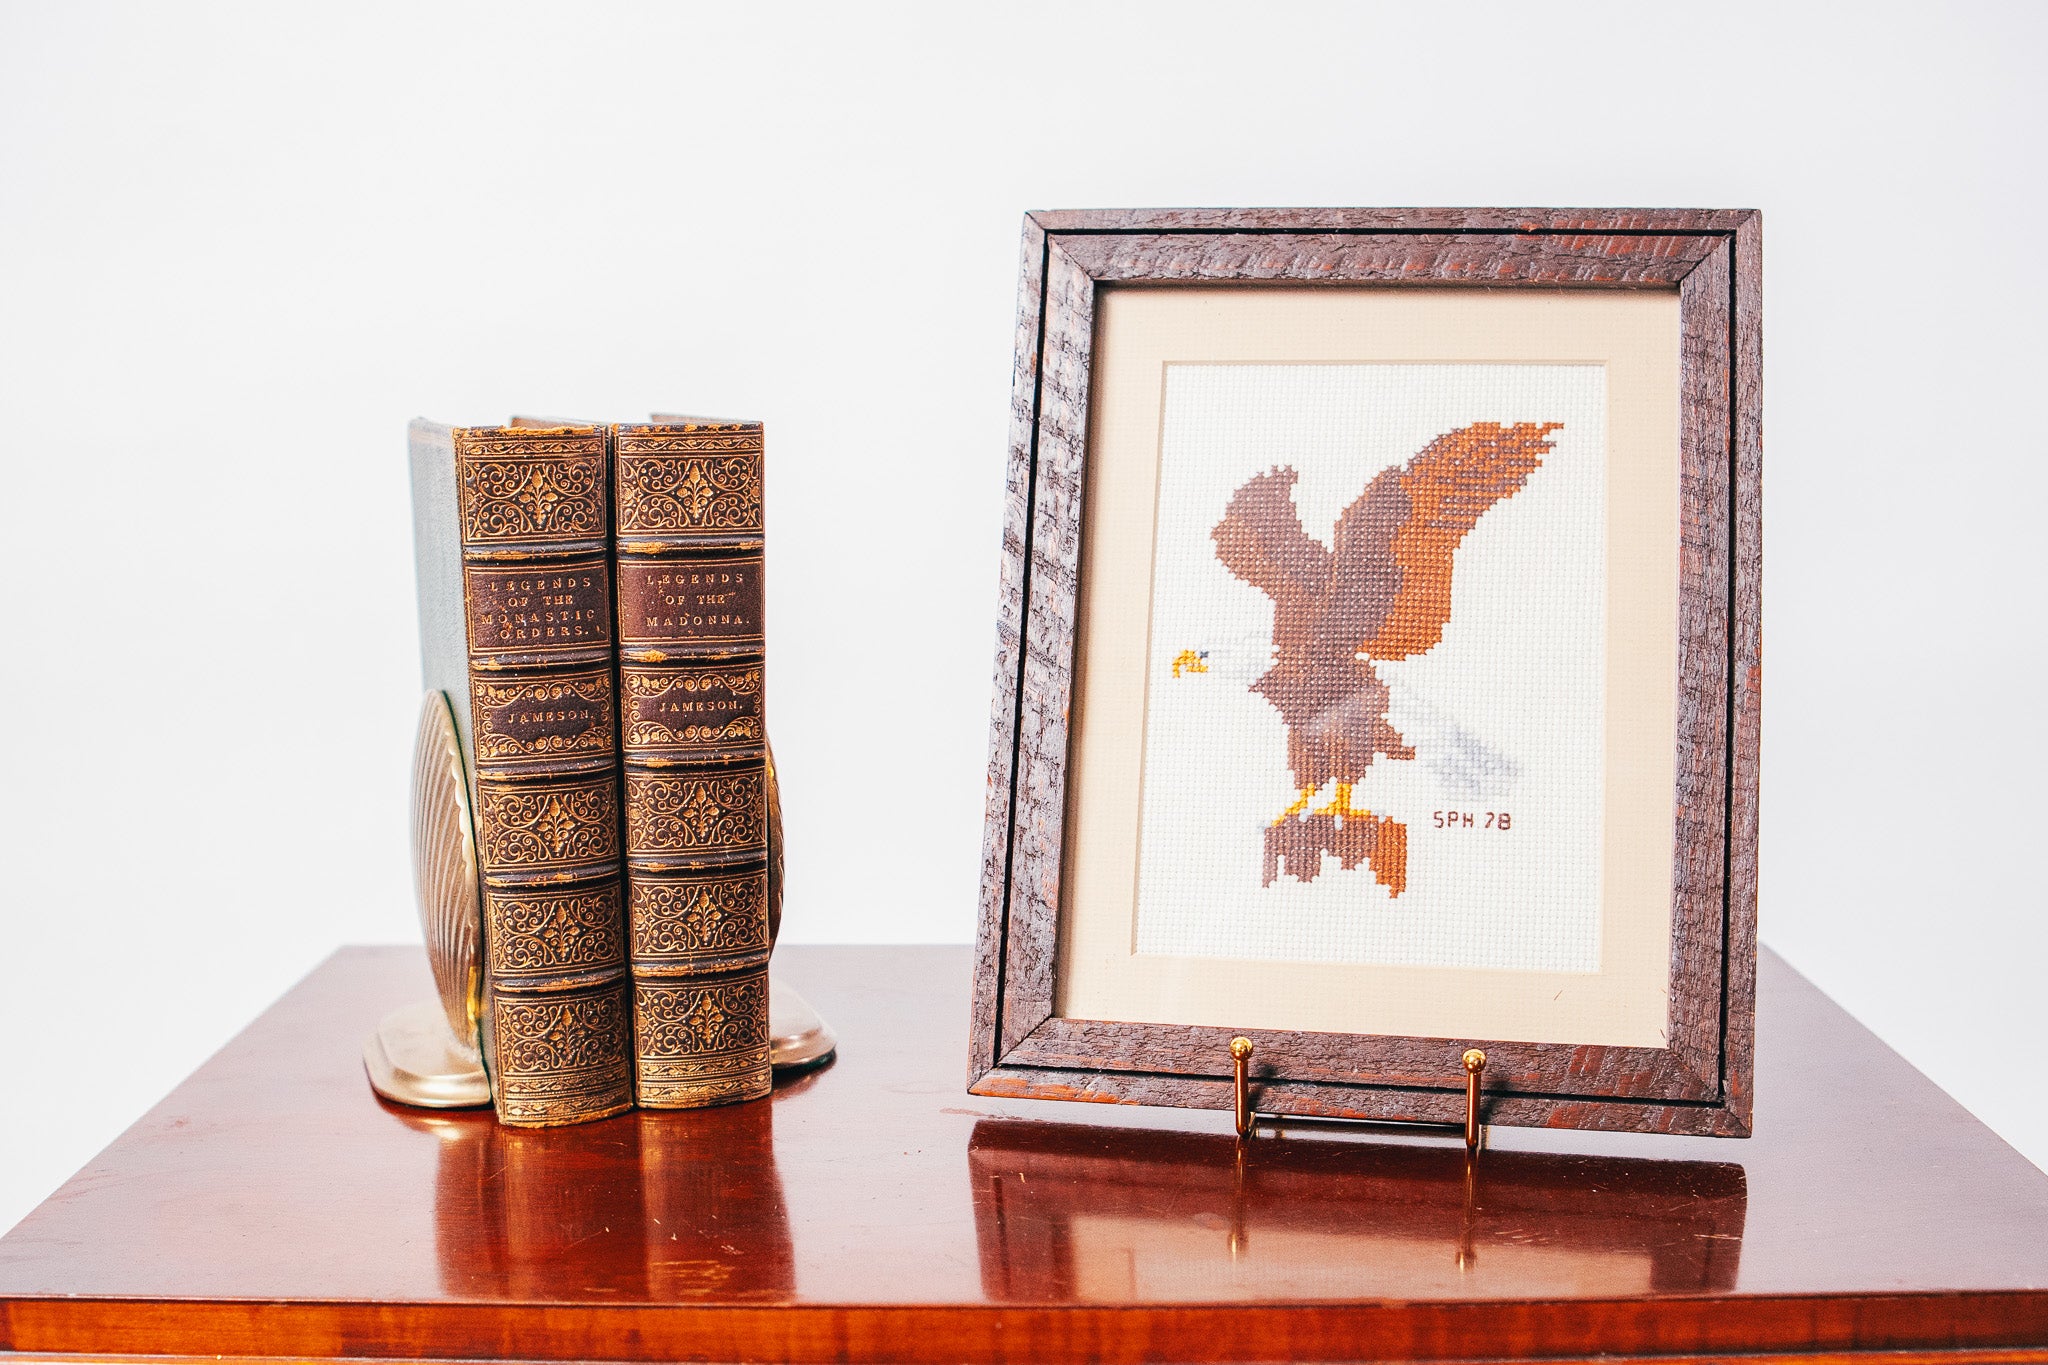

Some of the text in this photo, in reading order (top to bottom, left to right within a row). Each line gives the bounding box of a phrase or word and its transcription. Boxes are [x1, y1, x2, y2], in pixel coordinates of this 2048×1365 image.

[489, 577, 592, 592] LEGENDS
[646, 573, 744, 585] LEGENDS
[508, 594, 574, 607] OF THE
[665, 594, 726, 606] OF THE
[480, 609, 595, 625] MONASTIC
[646, 614, 750, 627] MADONNA.
[500, 625, 589, 640] ORDERS.
[658, 700, 743, 713] JAMESON.
[1433, 811, 1511, 830] SPH 78
